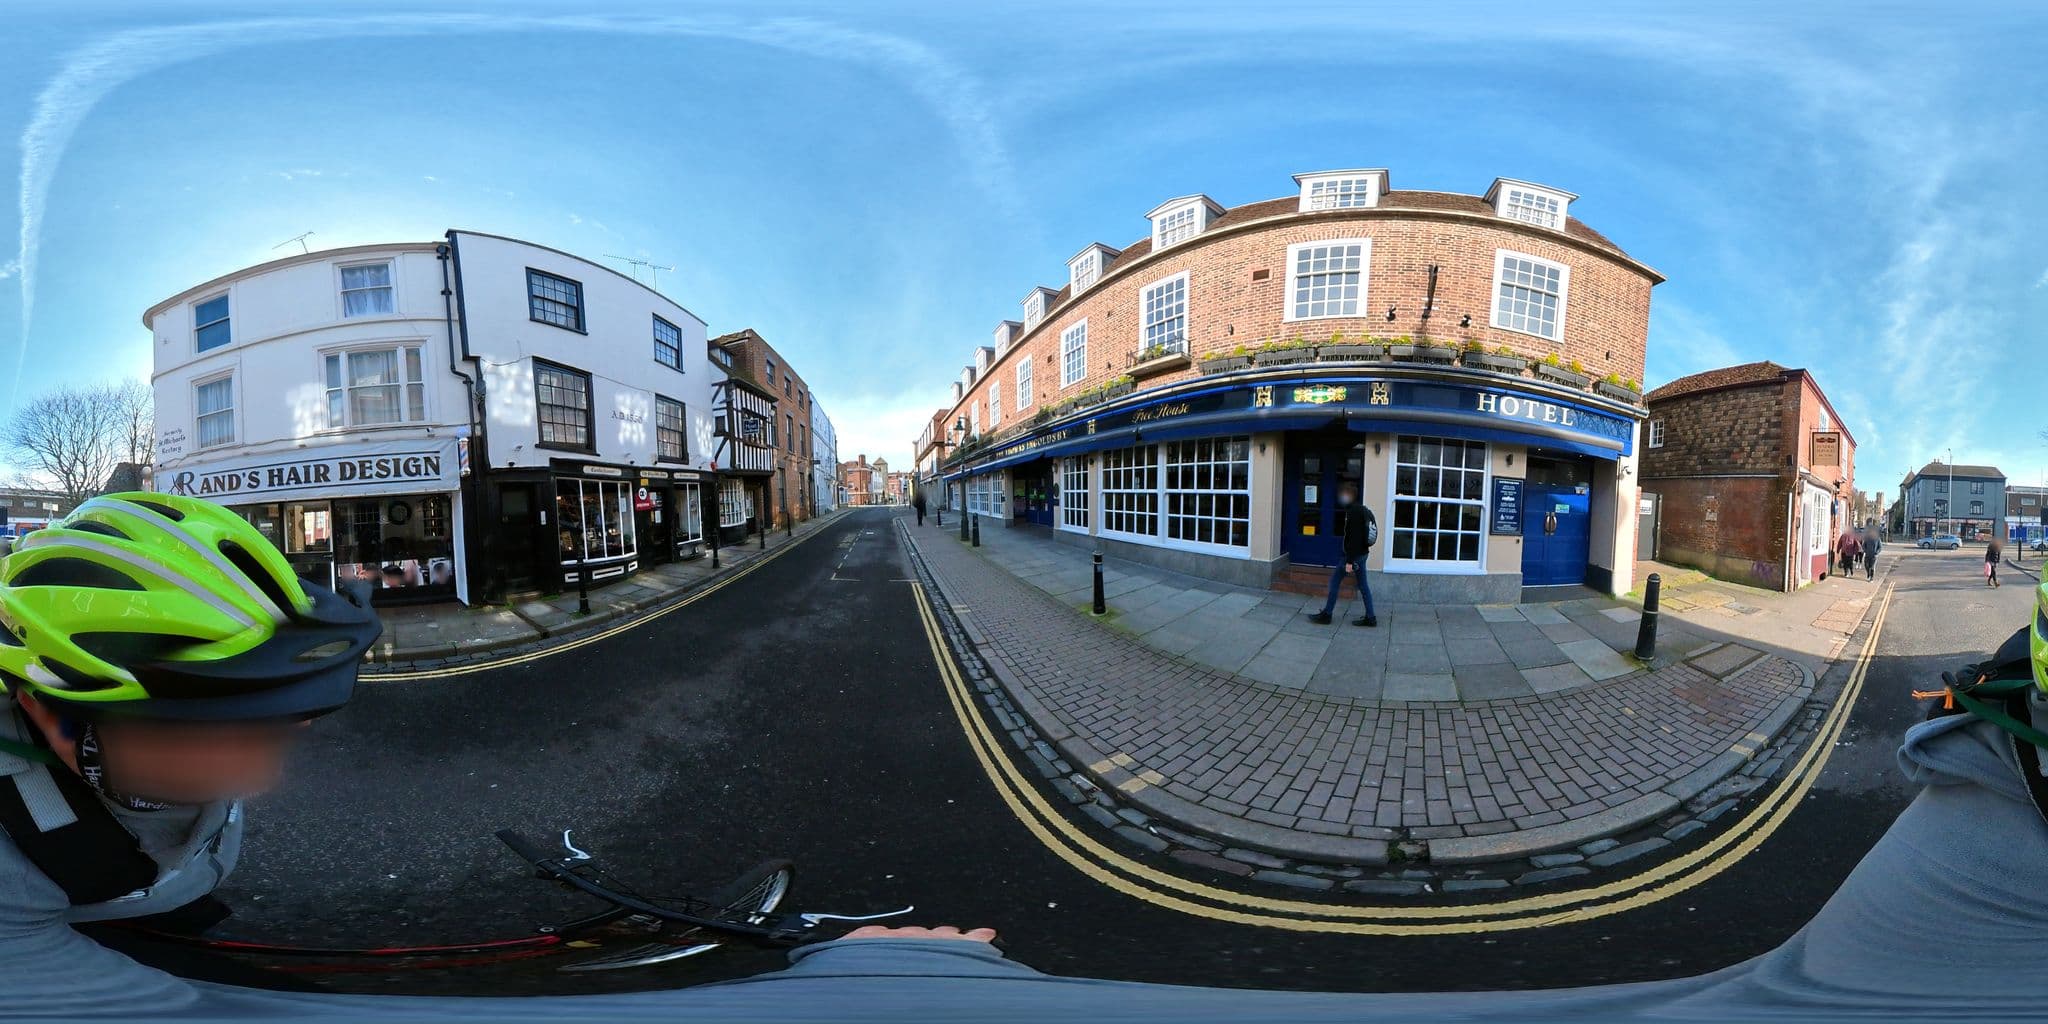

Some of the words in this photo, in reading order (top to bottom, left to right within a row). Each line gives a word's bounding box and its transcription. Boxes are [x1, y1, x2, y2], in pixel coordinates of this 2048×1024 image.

[1132, 408, 1153, 423] Free
[1154, 403, 1190, 419] House
[1477, 392, 1573, 426] HOTEL
[1026, 430, 1067, 450] INGOLDSBY
[267, 463, 331, 487] HAIR
[338, 456, 441, 481] DESIGN
